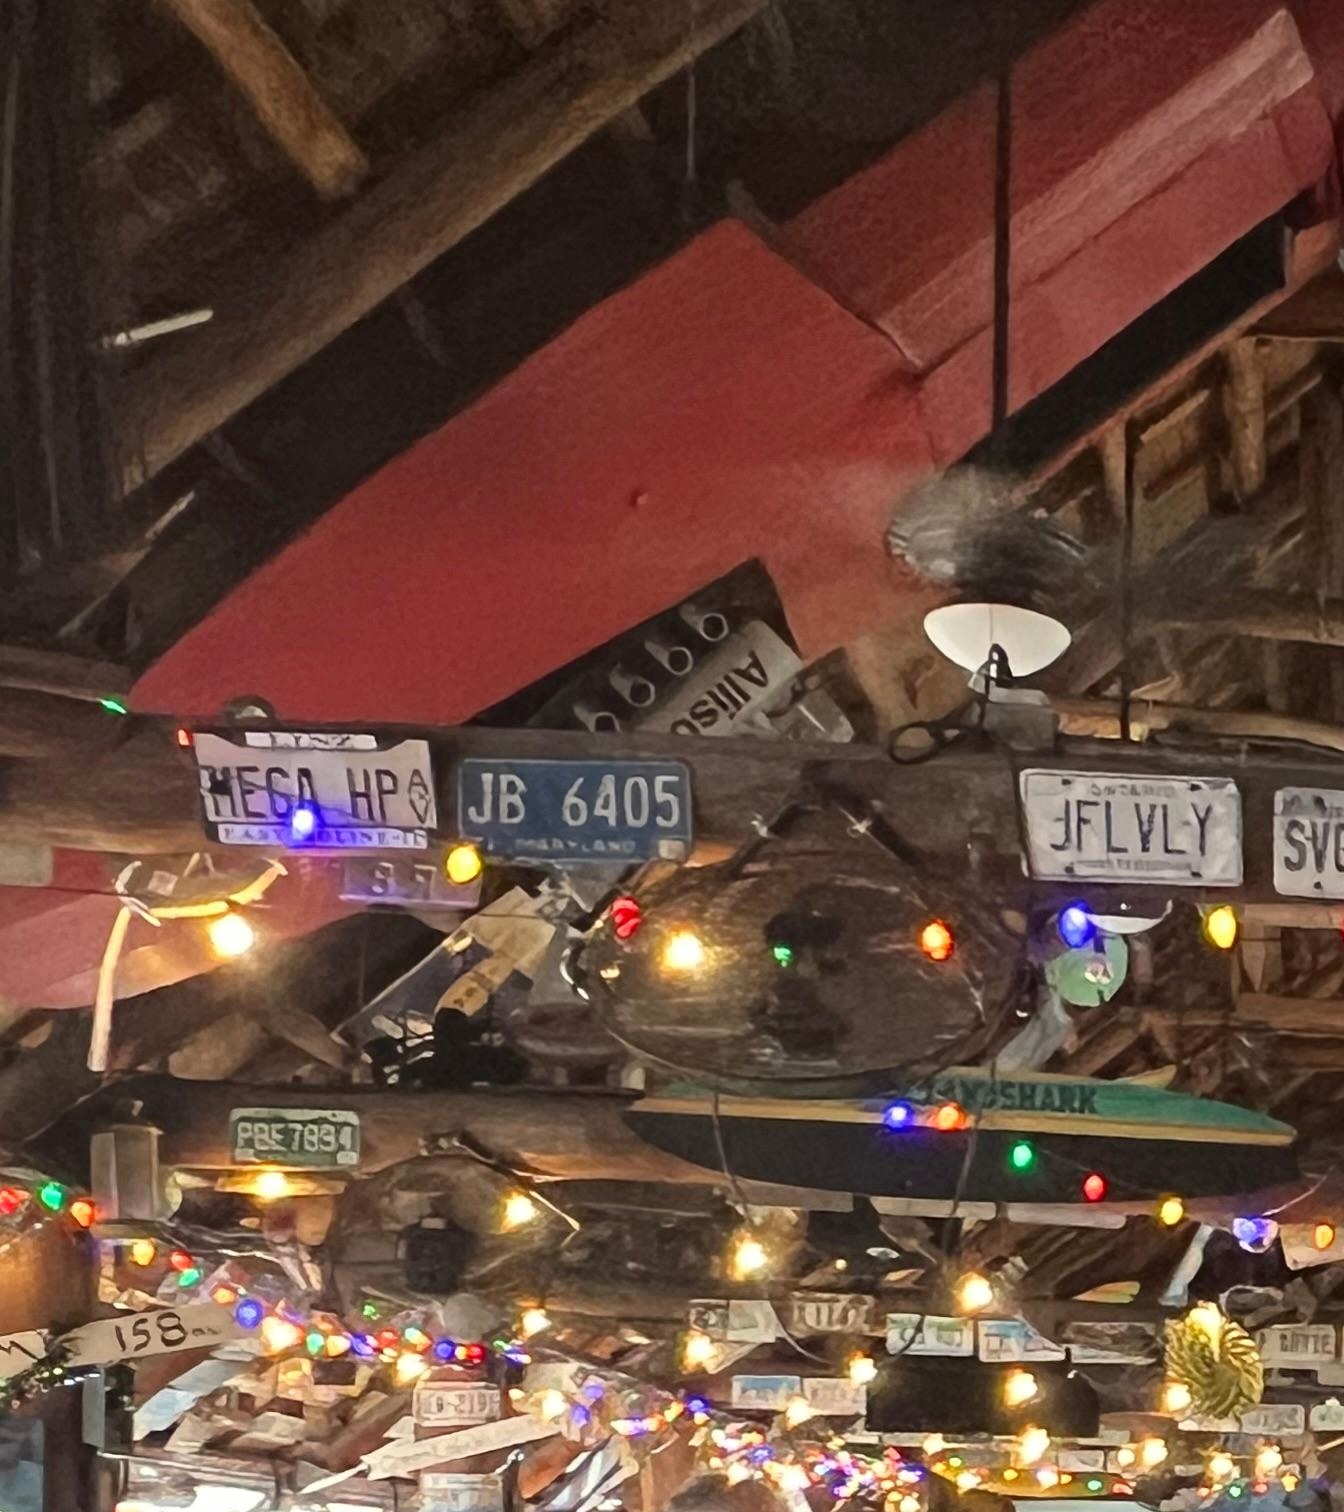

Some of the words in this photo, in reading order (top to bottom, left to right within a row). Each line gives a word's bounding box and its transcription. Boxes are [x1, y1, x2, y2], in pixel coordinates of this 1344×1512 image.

[346, 768, 398, 826] HP
[468, 773, 528, 825] JB
[562, 774, 680, 829] 6405
[1049, 799, 1213, 857] JFLVLY
[114, 1312, 188, 1353] 158
